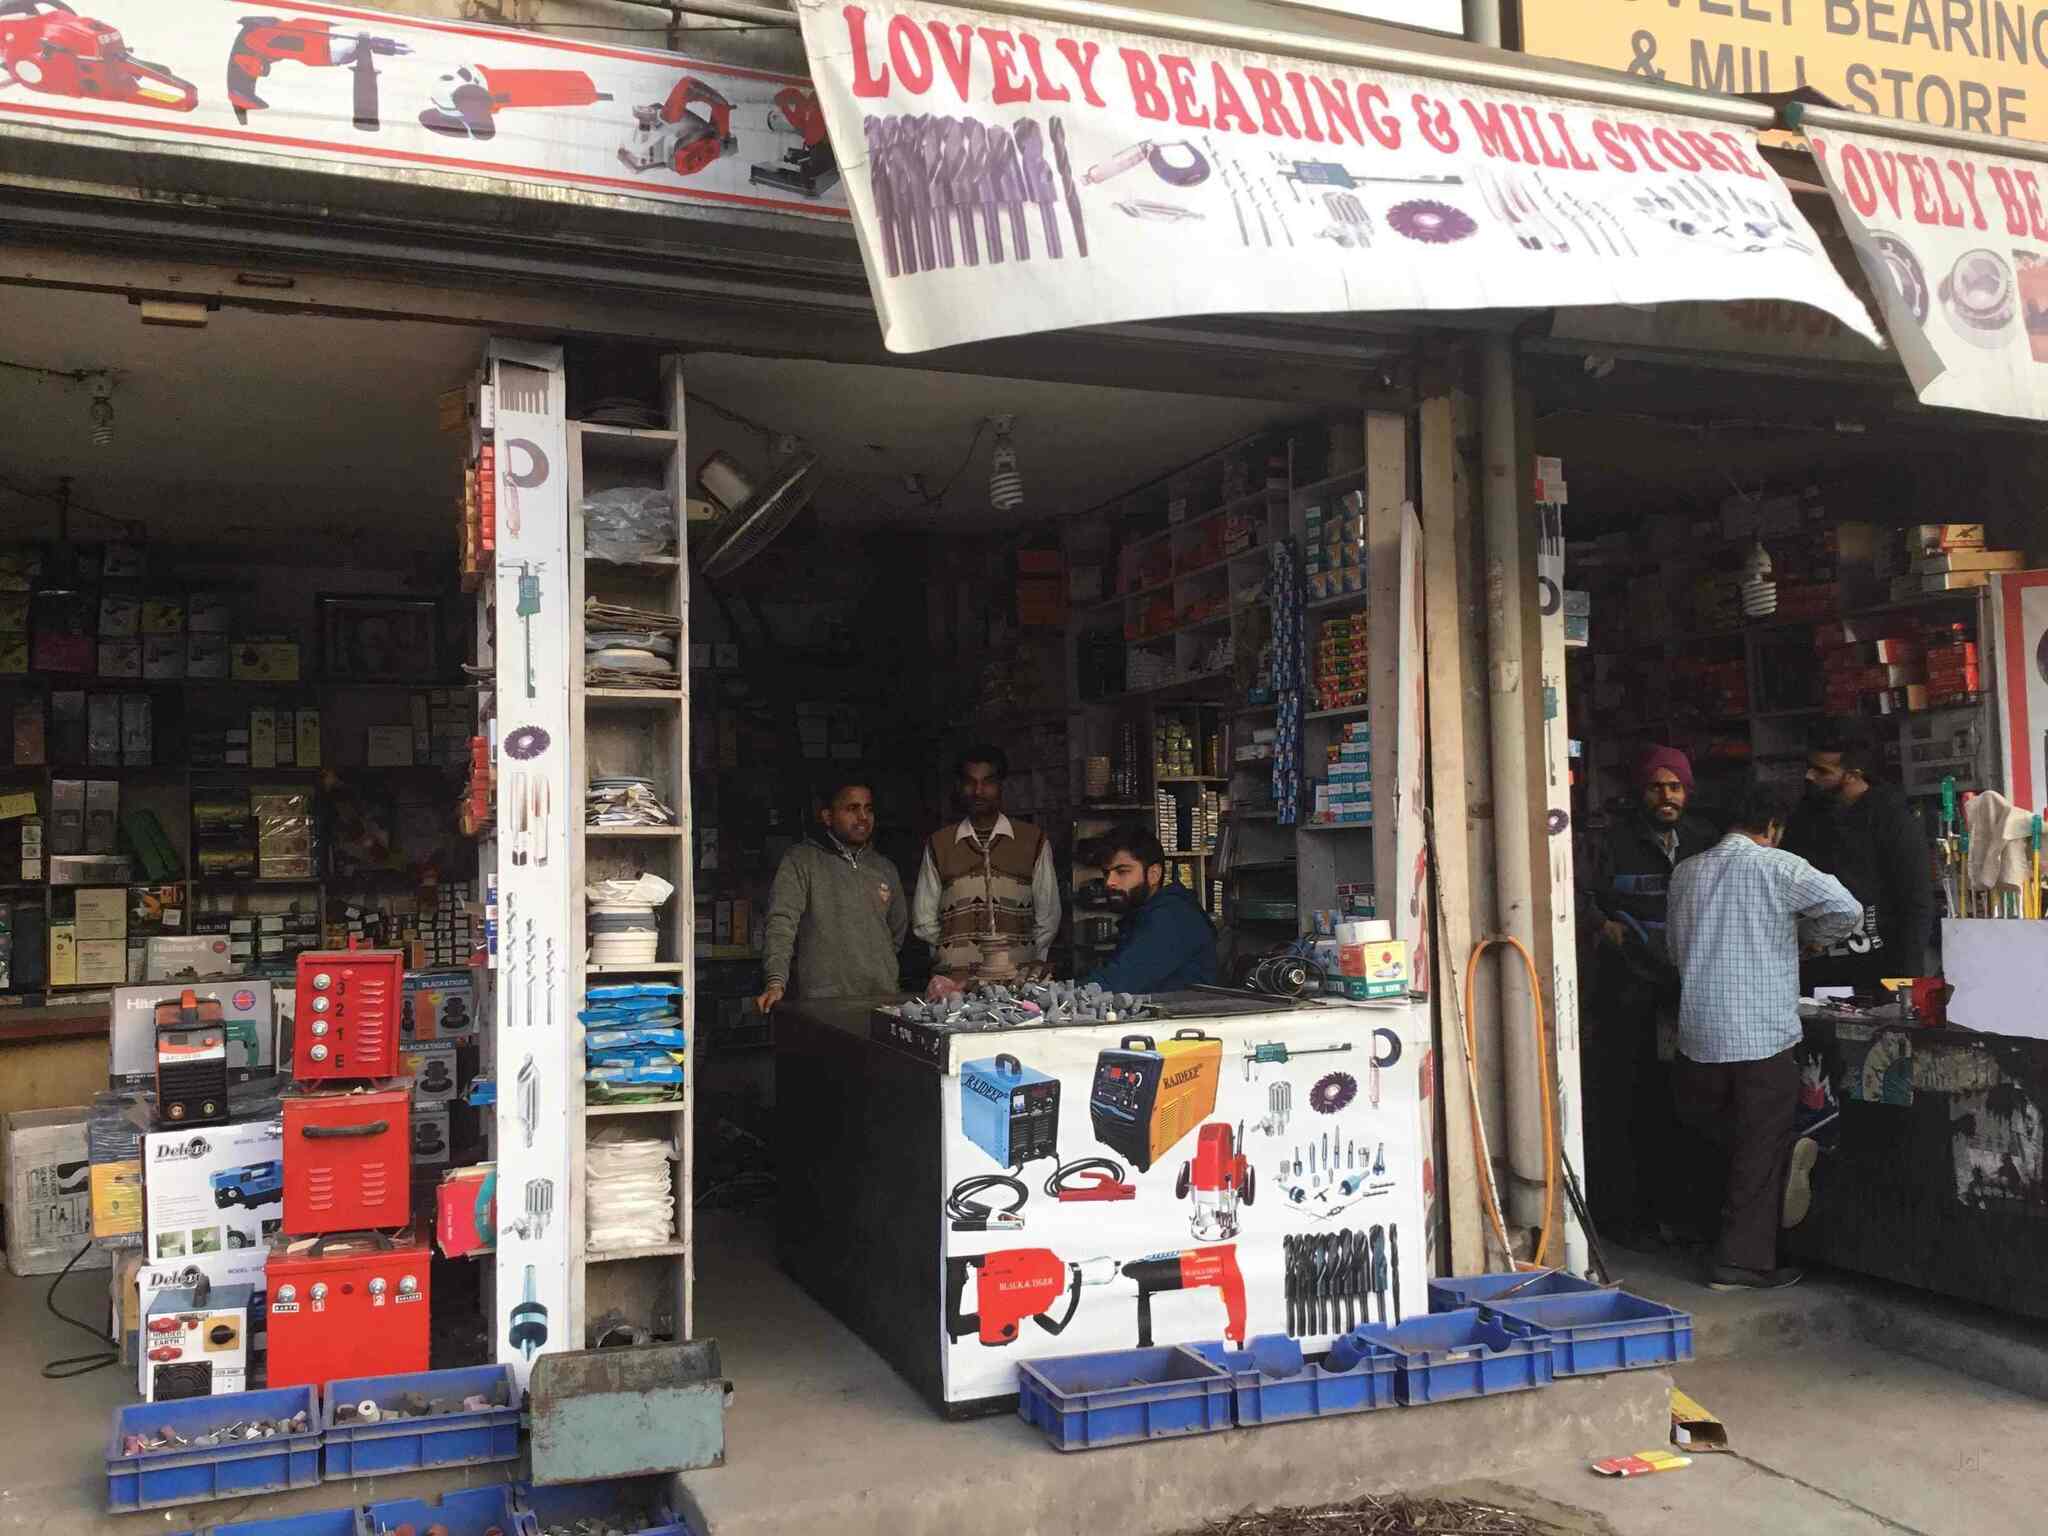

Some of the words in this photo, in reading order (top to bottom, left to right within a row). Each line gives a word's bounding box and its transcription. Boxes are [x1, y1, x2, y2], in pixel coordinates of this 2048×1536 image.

[1627, 29, 1666, 82] &
[843, 5, 1106, 107] LOVELY
[1119, 47, 1402, 150] BEARING
[1411, 93, 1461, 153] &
[1459, 98, 1600, 172] MILL
[1592, 118, 1767, 181] STORE
[336, 982, 345, 996] 3
[336, 1003, 344, 1017] 2
[336, 1026, 344, 1041] 1
[335, 1054, 345, 1068] E
